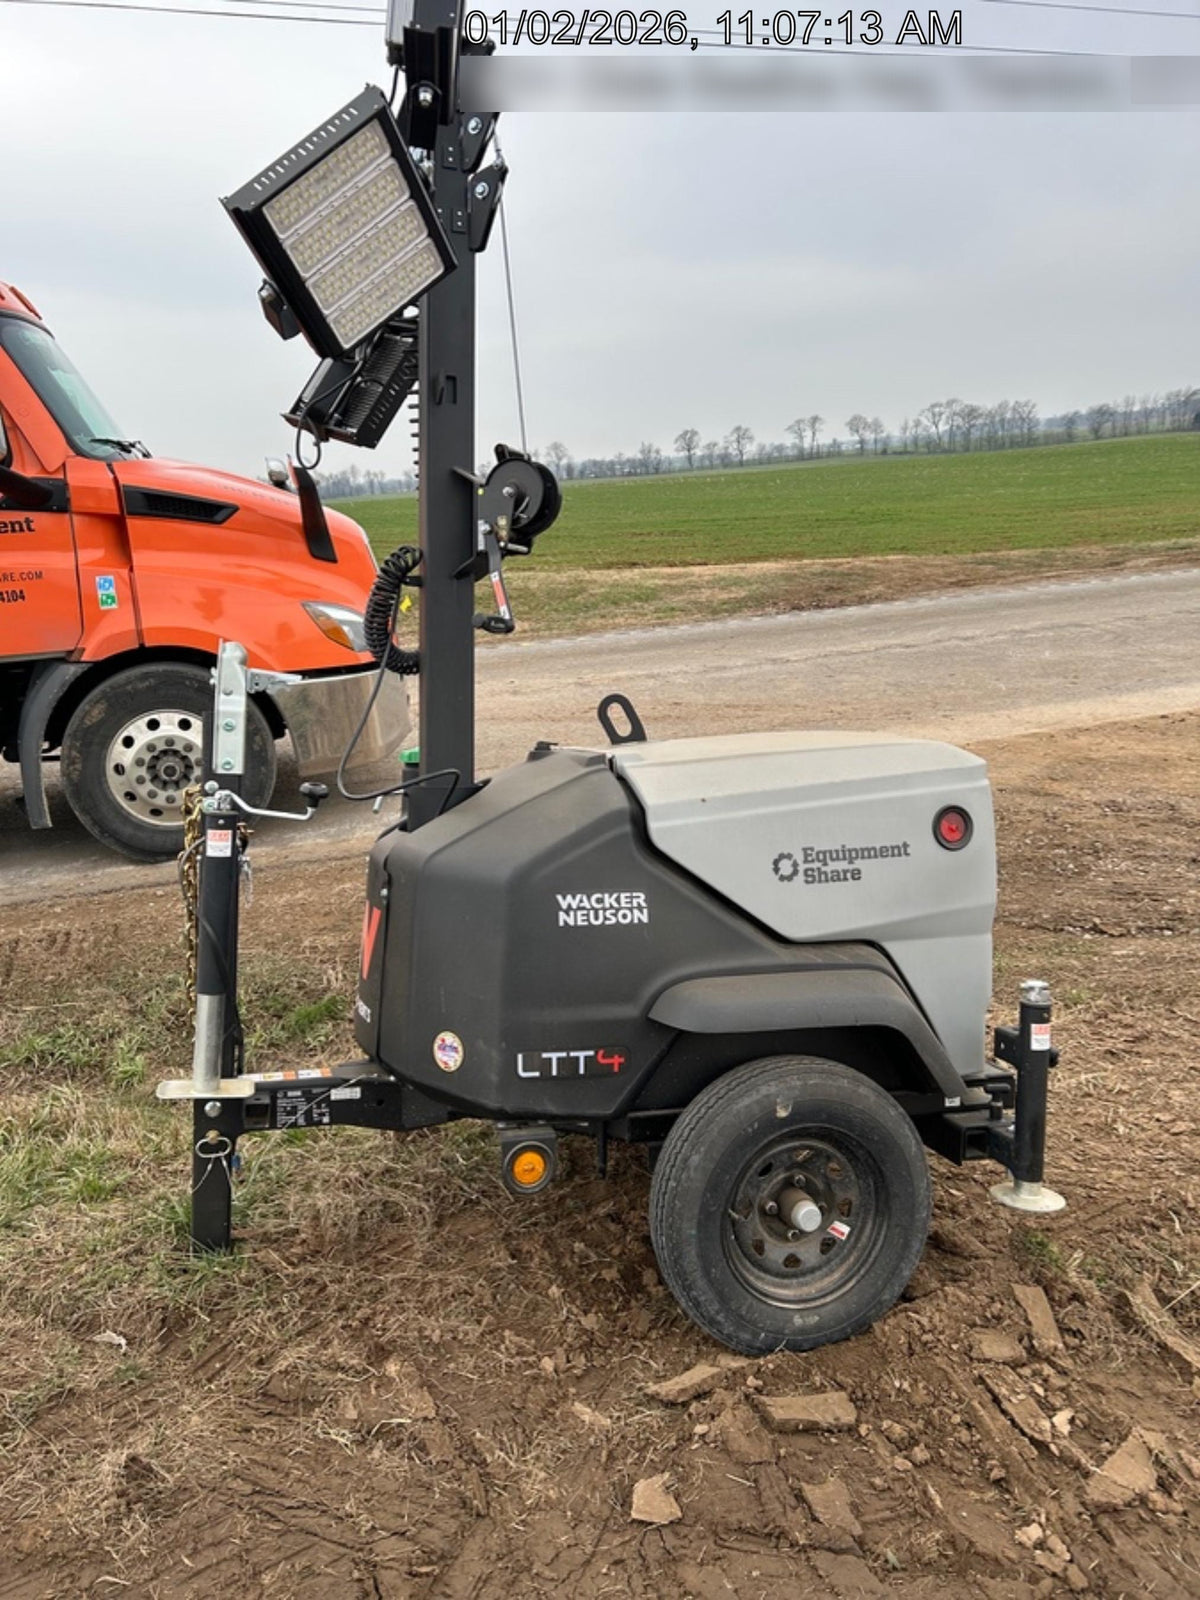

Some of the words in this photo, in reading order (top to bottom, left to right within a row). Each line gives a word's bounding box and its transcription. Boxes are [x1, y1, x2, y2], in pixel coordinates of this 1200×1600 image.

[0, 570, 43, 582] RE.COM
[802, 841, 911, 867] Equipment
[803, 867, 862, 884] Share
[555, 892, 648, 910] WACKER
[558, 908, 649, 927] NEUSON
[516, 1049, 625, 1078] LTT4
